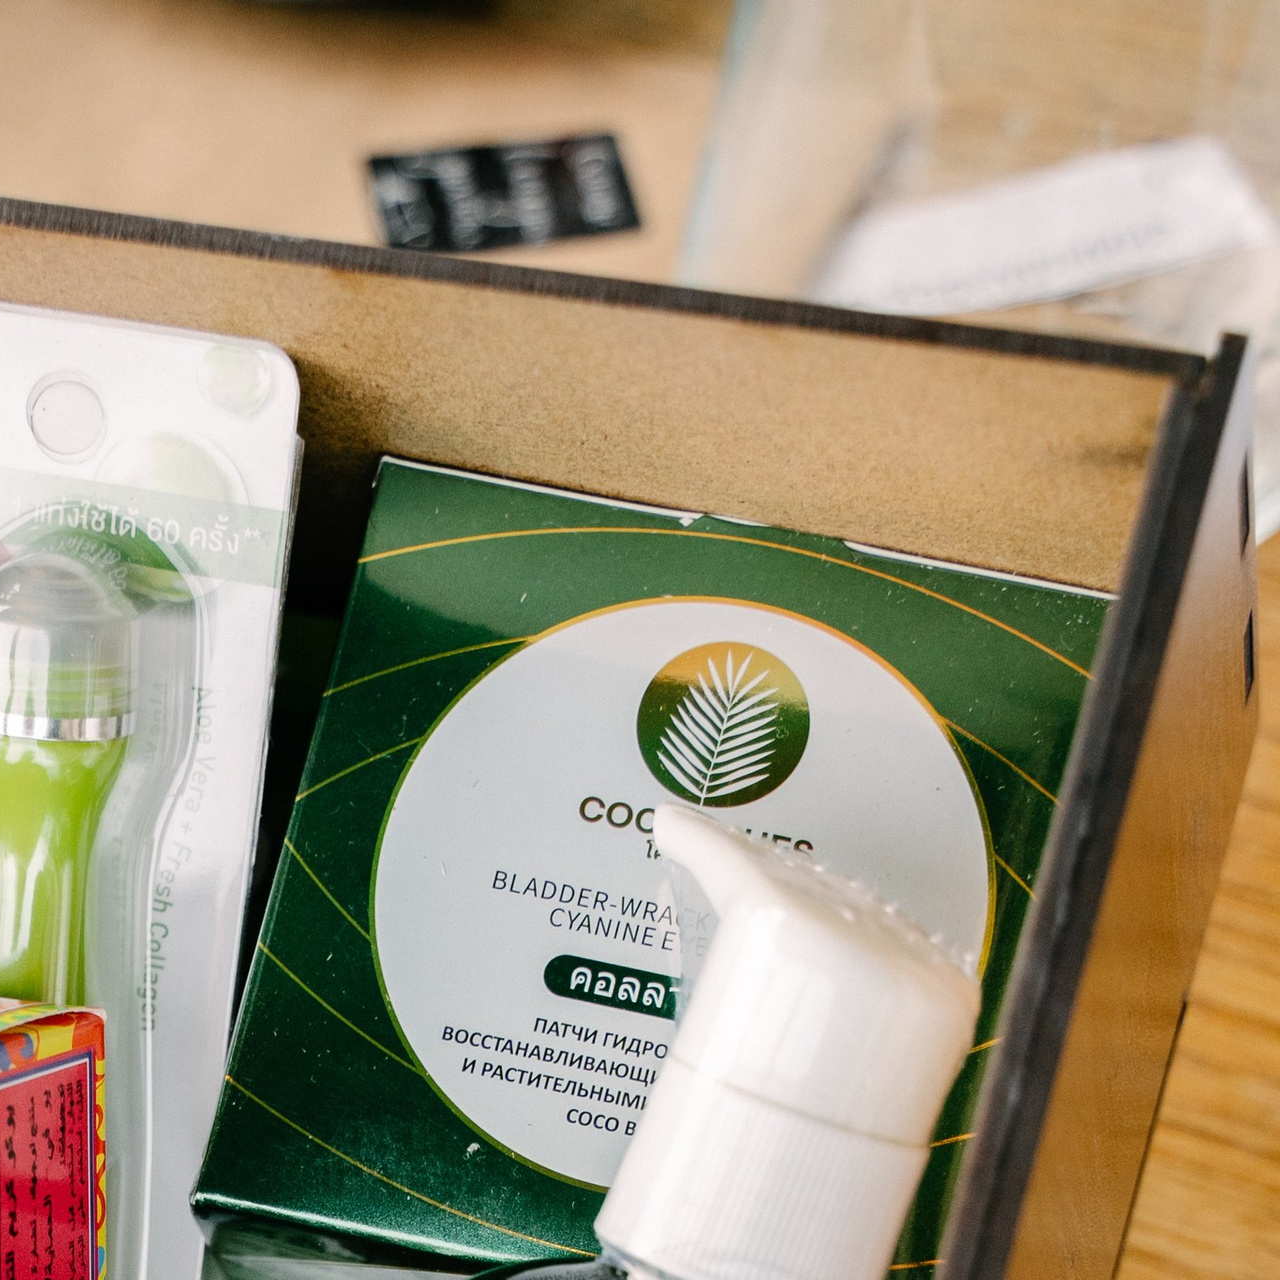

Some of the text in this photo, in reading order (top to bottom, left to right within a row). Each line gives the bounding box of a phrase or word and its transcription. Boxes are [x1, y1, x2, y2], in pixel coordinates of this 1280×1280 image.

[147, 517, 180, 545] 60
[152, 842, 192, 914] Fresh
[549, 908, 658, 947] CYANINE
[442, 1026, 658, 1087] ВОССТАНАВЛИВАЮЩИ
[533, 1017, 669, 1060] ПАТЧИ ГИДРО
[461, 1058, 477, 1074] И
